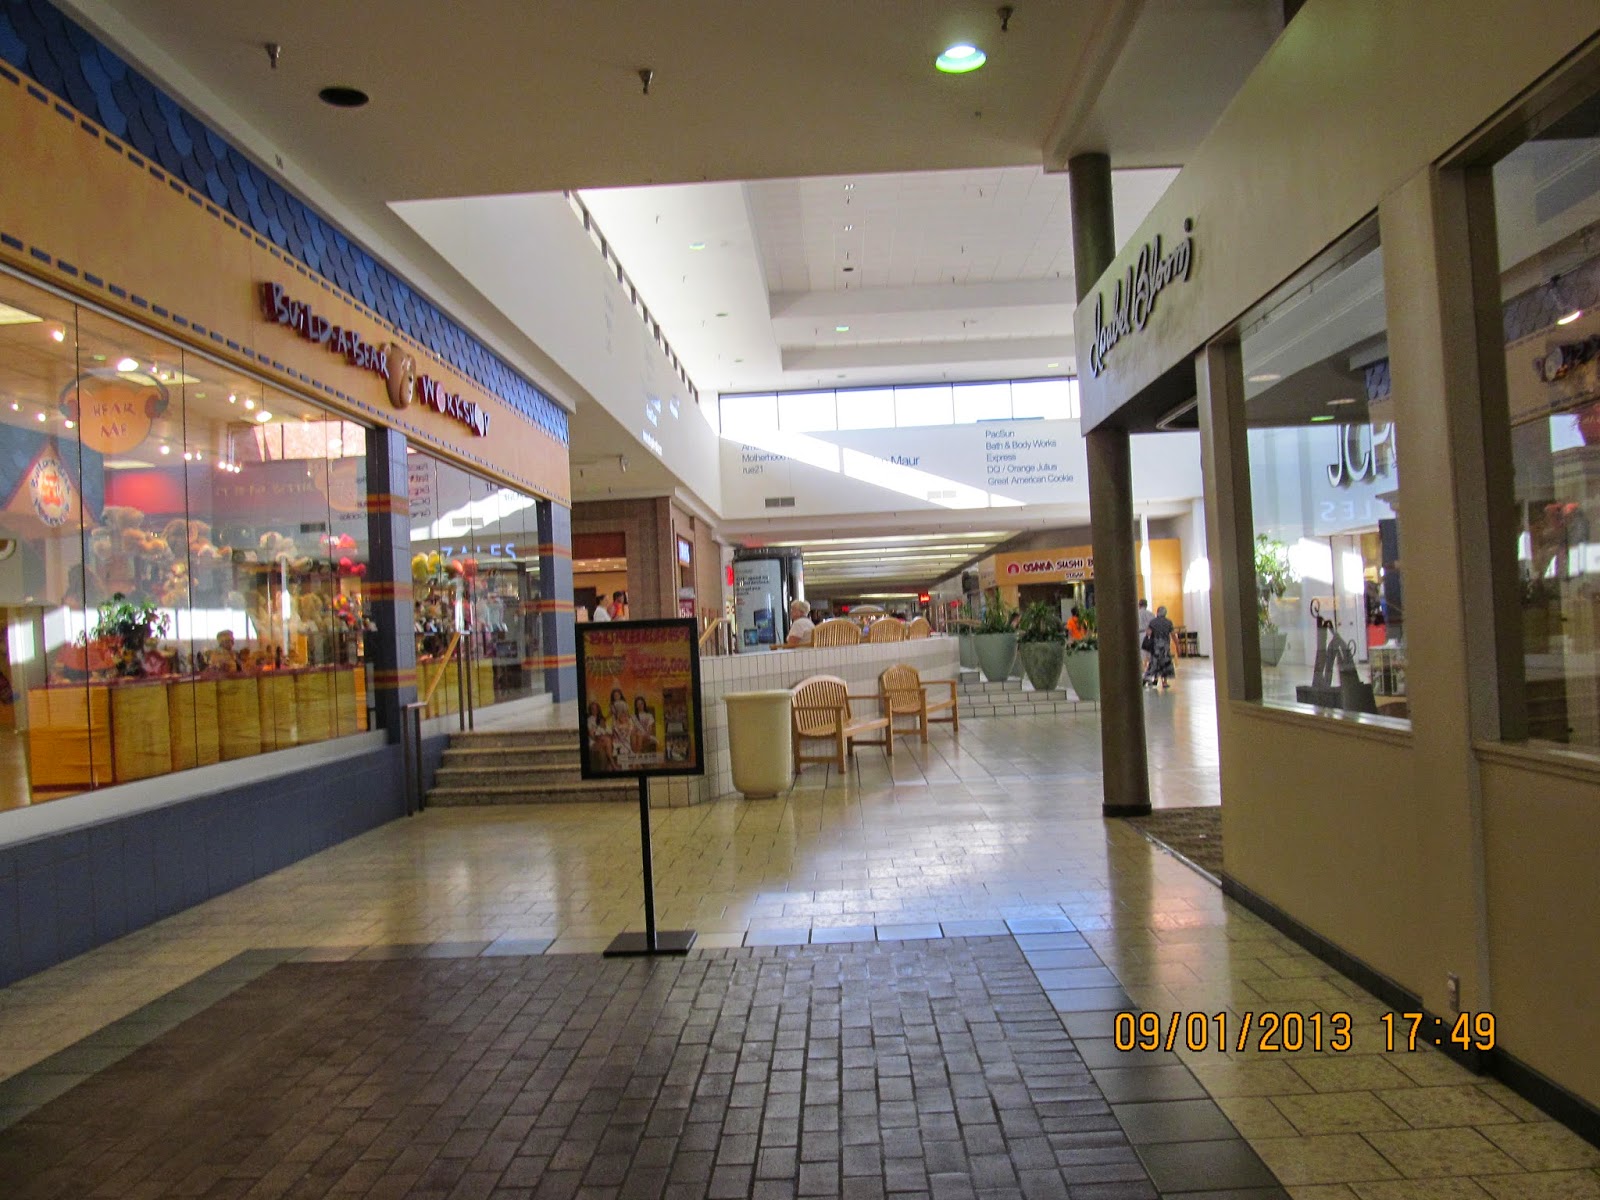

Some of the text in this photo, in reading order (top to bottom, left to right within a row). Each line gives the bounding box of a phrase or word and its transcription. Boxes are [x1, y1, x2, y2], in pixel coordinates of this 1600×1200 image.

[1090, 217, 1193, 379] Isabel Bloom
[418, 374, 490, 437] WORKSHOP
[985, 429, 1015, 439] PacSun
[985, 441, 1003, 451] Bath
[1011, 439, 1032, 450] Body
[1032, 439, 1057, 449] Works
[891, 455, 920, 467] Maur
[986, 453, 1017, 463] Express
[742, 465, 765, 475] rue21
[1006, 463, 1036, 473] Orange
[1037, 462, 1058, 472] Julius
[987, 473, 1074, 486] Great American Cookie
[1022, 561, 1055, 573] OSAKA
[1056, 560, 1084, 570] SUSHI
